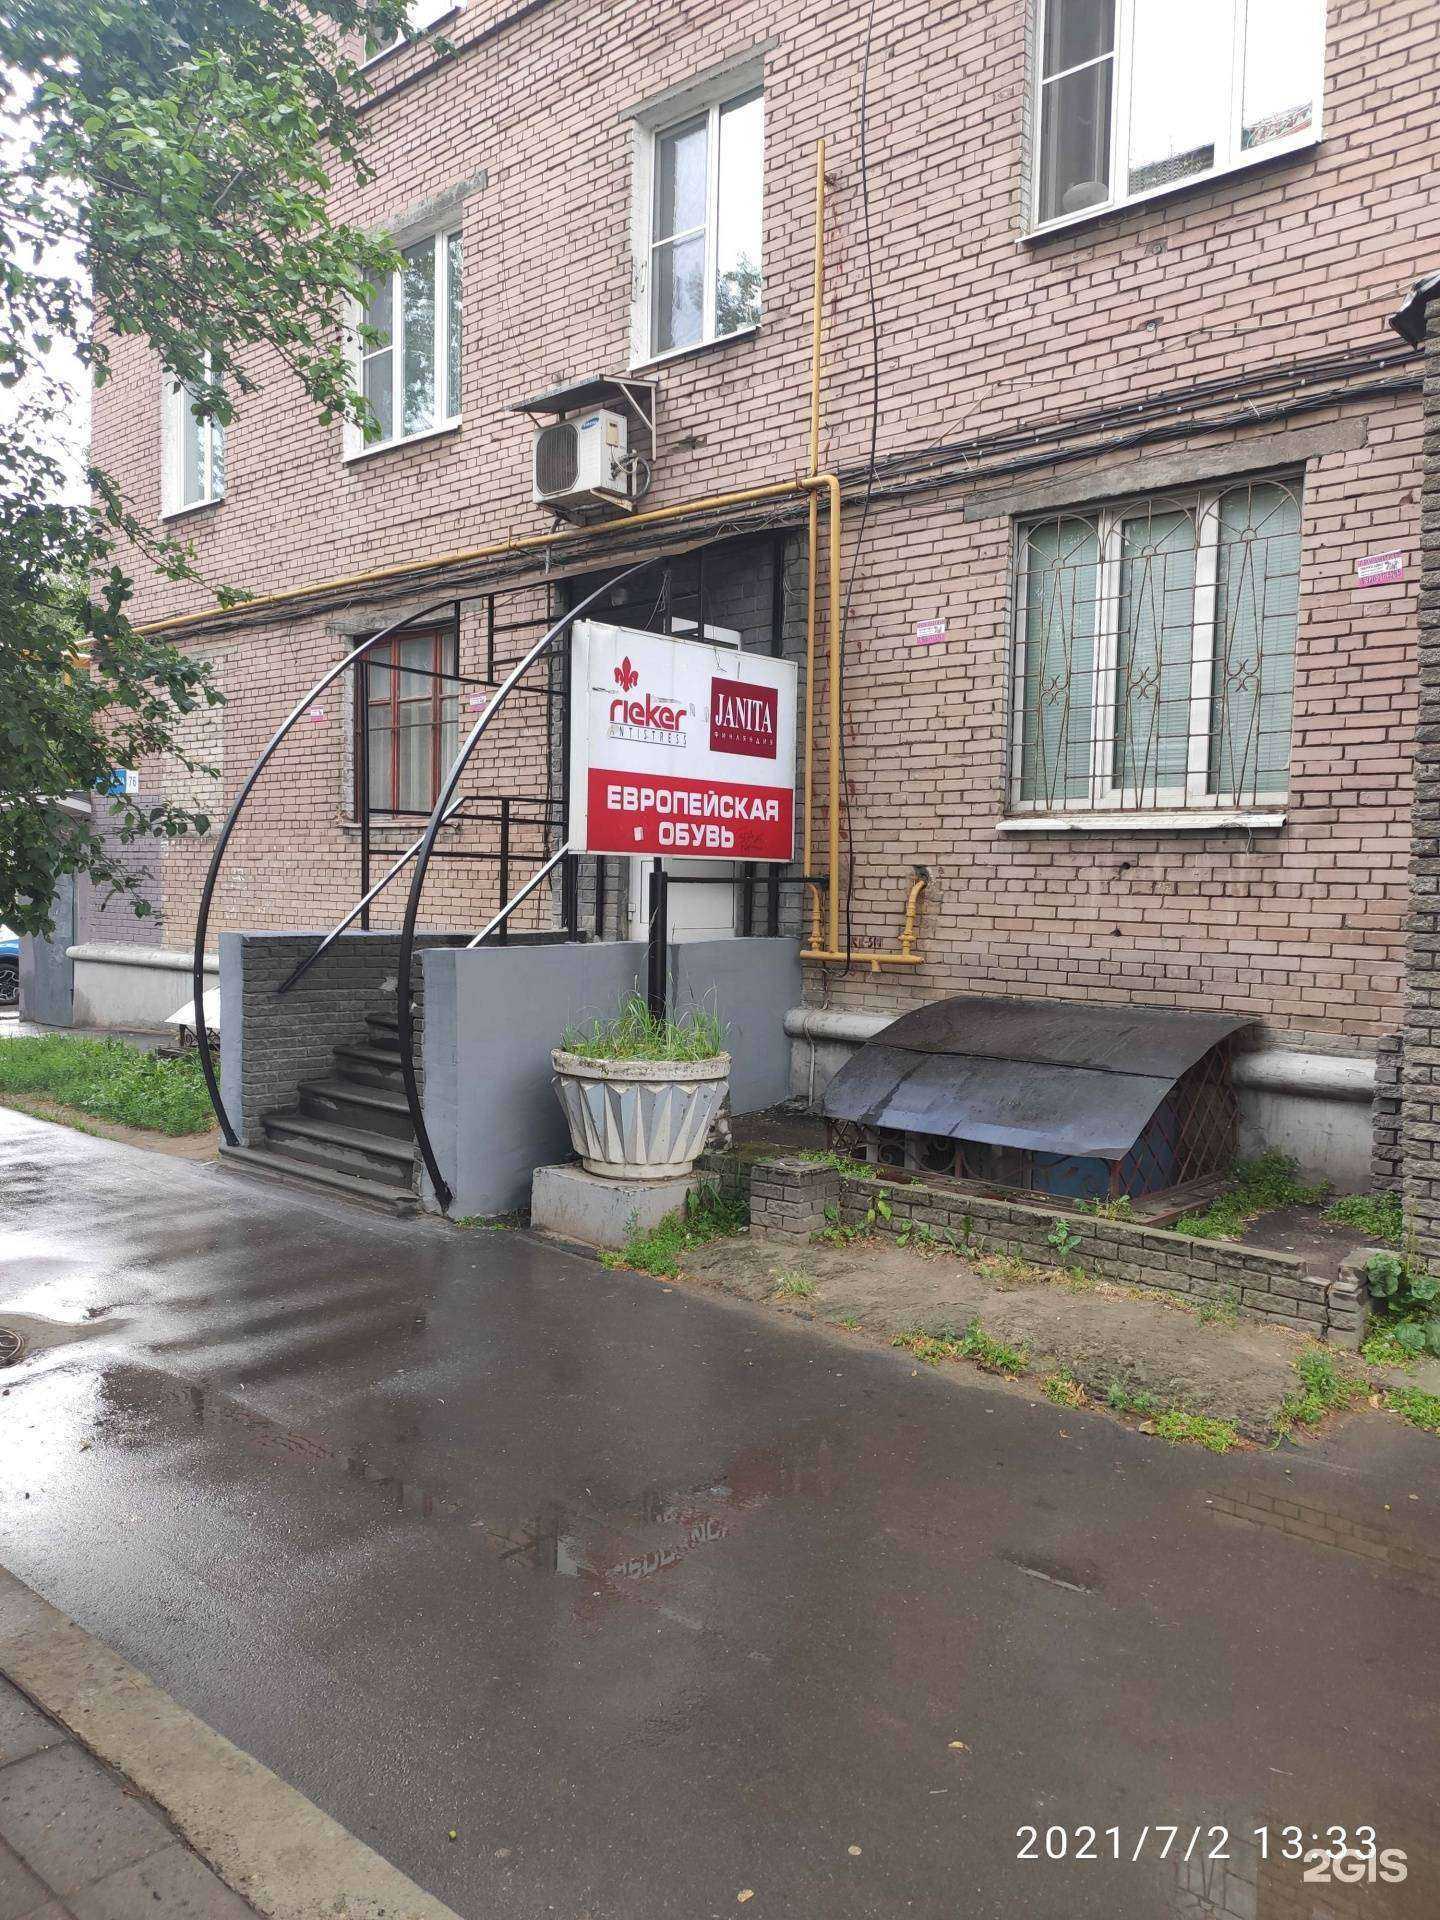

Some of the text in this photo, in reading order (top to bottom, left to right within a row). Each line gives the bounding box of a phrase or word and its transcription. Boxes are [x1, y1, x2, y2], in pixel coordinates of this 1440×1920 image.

[610, 693, 687, 730] rieker
[715, 693, 773, 733] JANITA
[609, 725, 687, 745] ANTISTRESS
[128, 776, 137, 787] 76
[607, 784, 779, 822] ЕВРОПЕЙСКАЯ
[658, 821, 735, 848] ОБУВЬ
